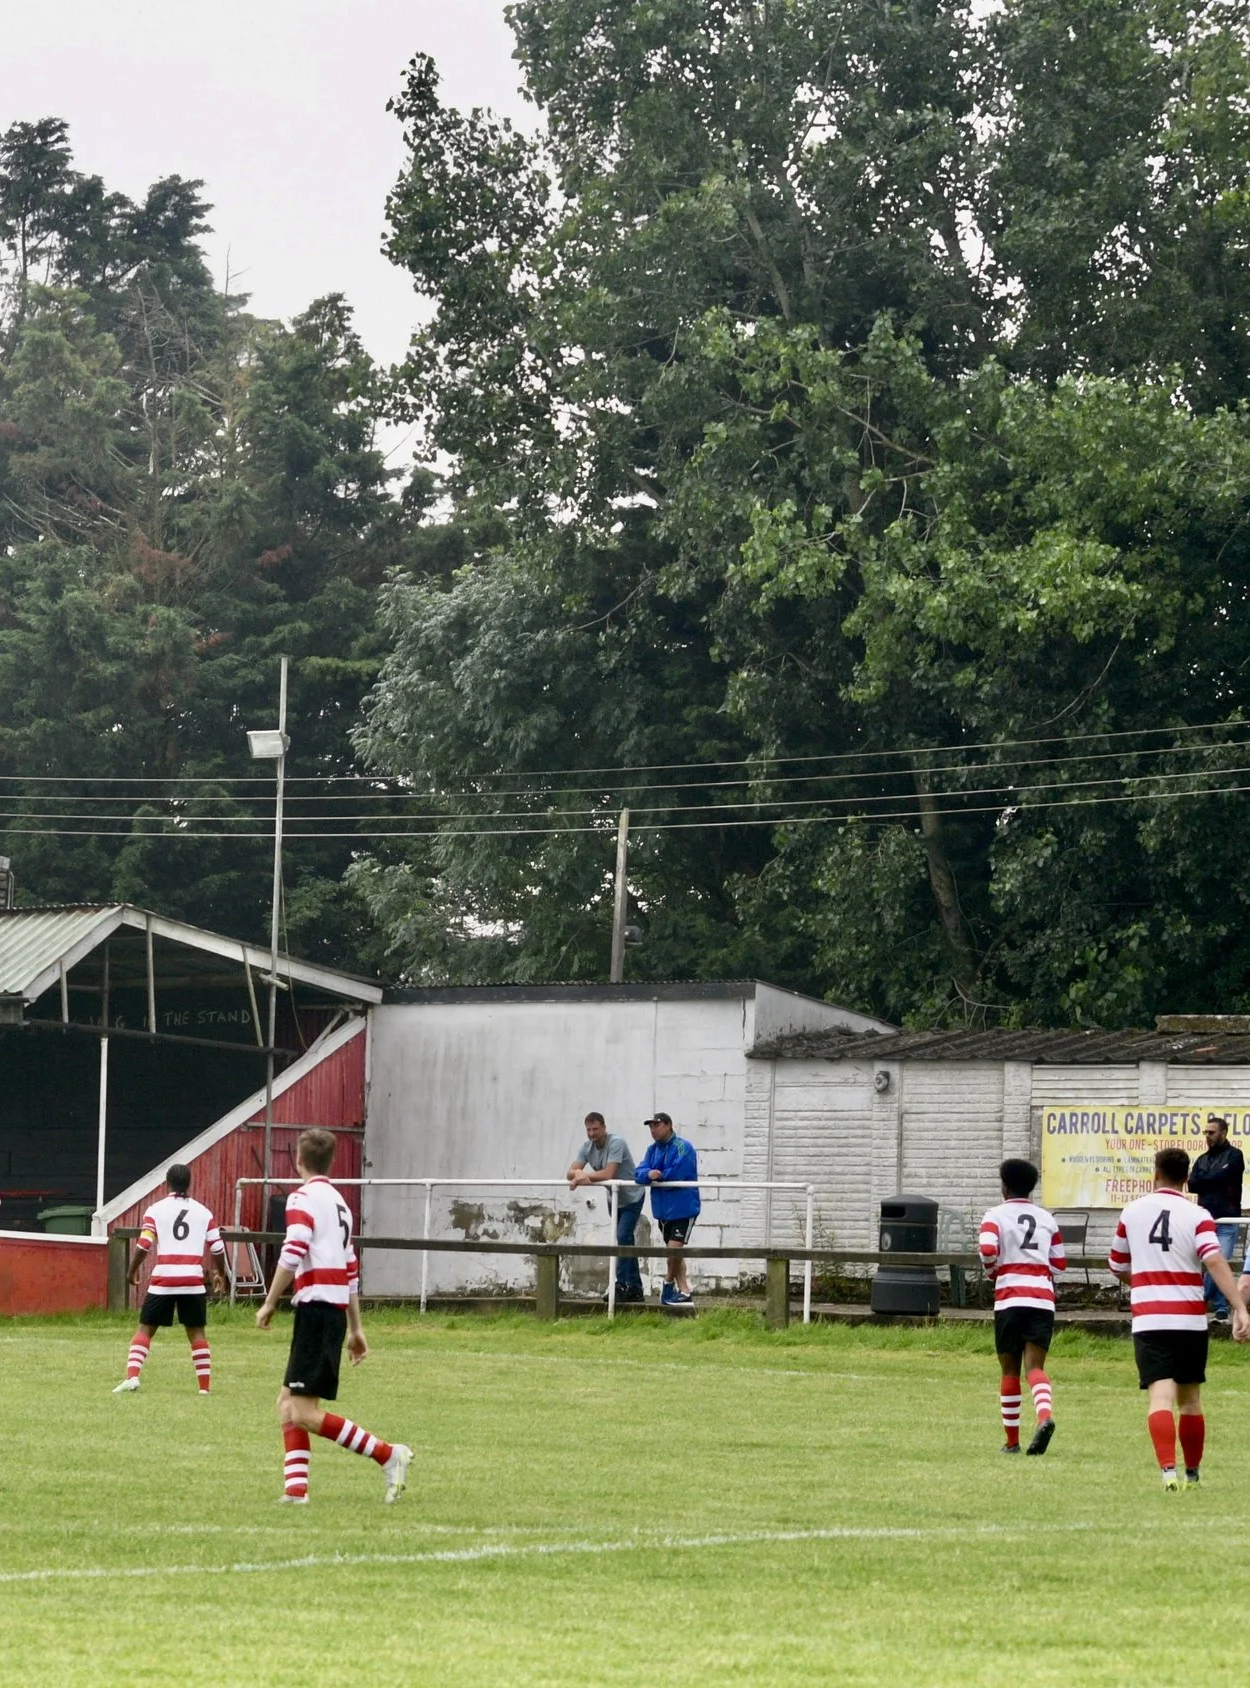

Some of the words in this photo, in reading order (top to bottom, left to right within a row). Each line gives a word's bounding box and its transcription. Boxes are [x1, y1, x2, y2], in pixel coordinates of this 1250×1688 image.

[164, 1010, 190, 1026] THE
[197, 1009, 251, 1025] STAND
[1046, 1111, 1119, 1135] CARROLL
[1124, 1112, 1201, 1136] CARPETS
[1105, 1138, 1127, 1150] YOUR
[1105, 1178, 1154, 1193] FREEPHO
[172, 1209, 190, 1241] 6
[336, 1203, 351, 1250] 5
[1016, 1213, 1039, 1251] 2
[1148, 1209, 1173, 1252] 4
